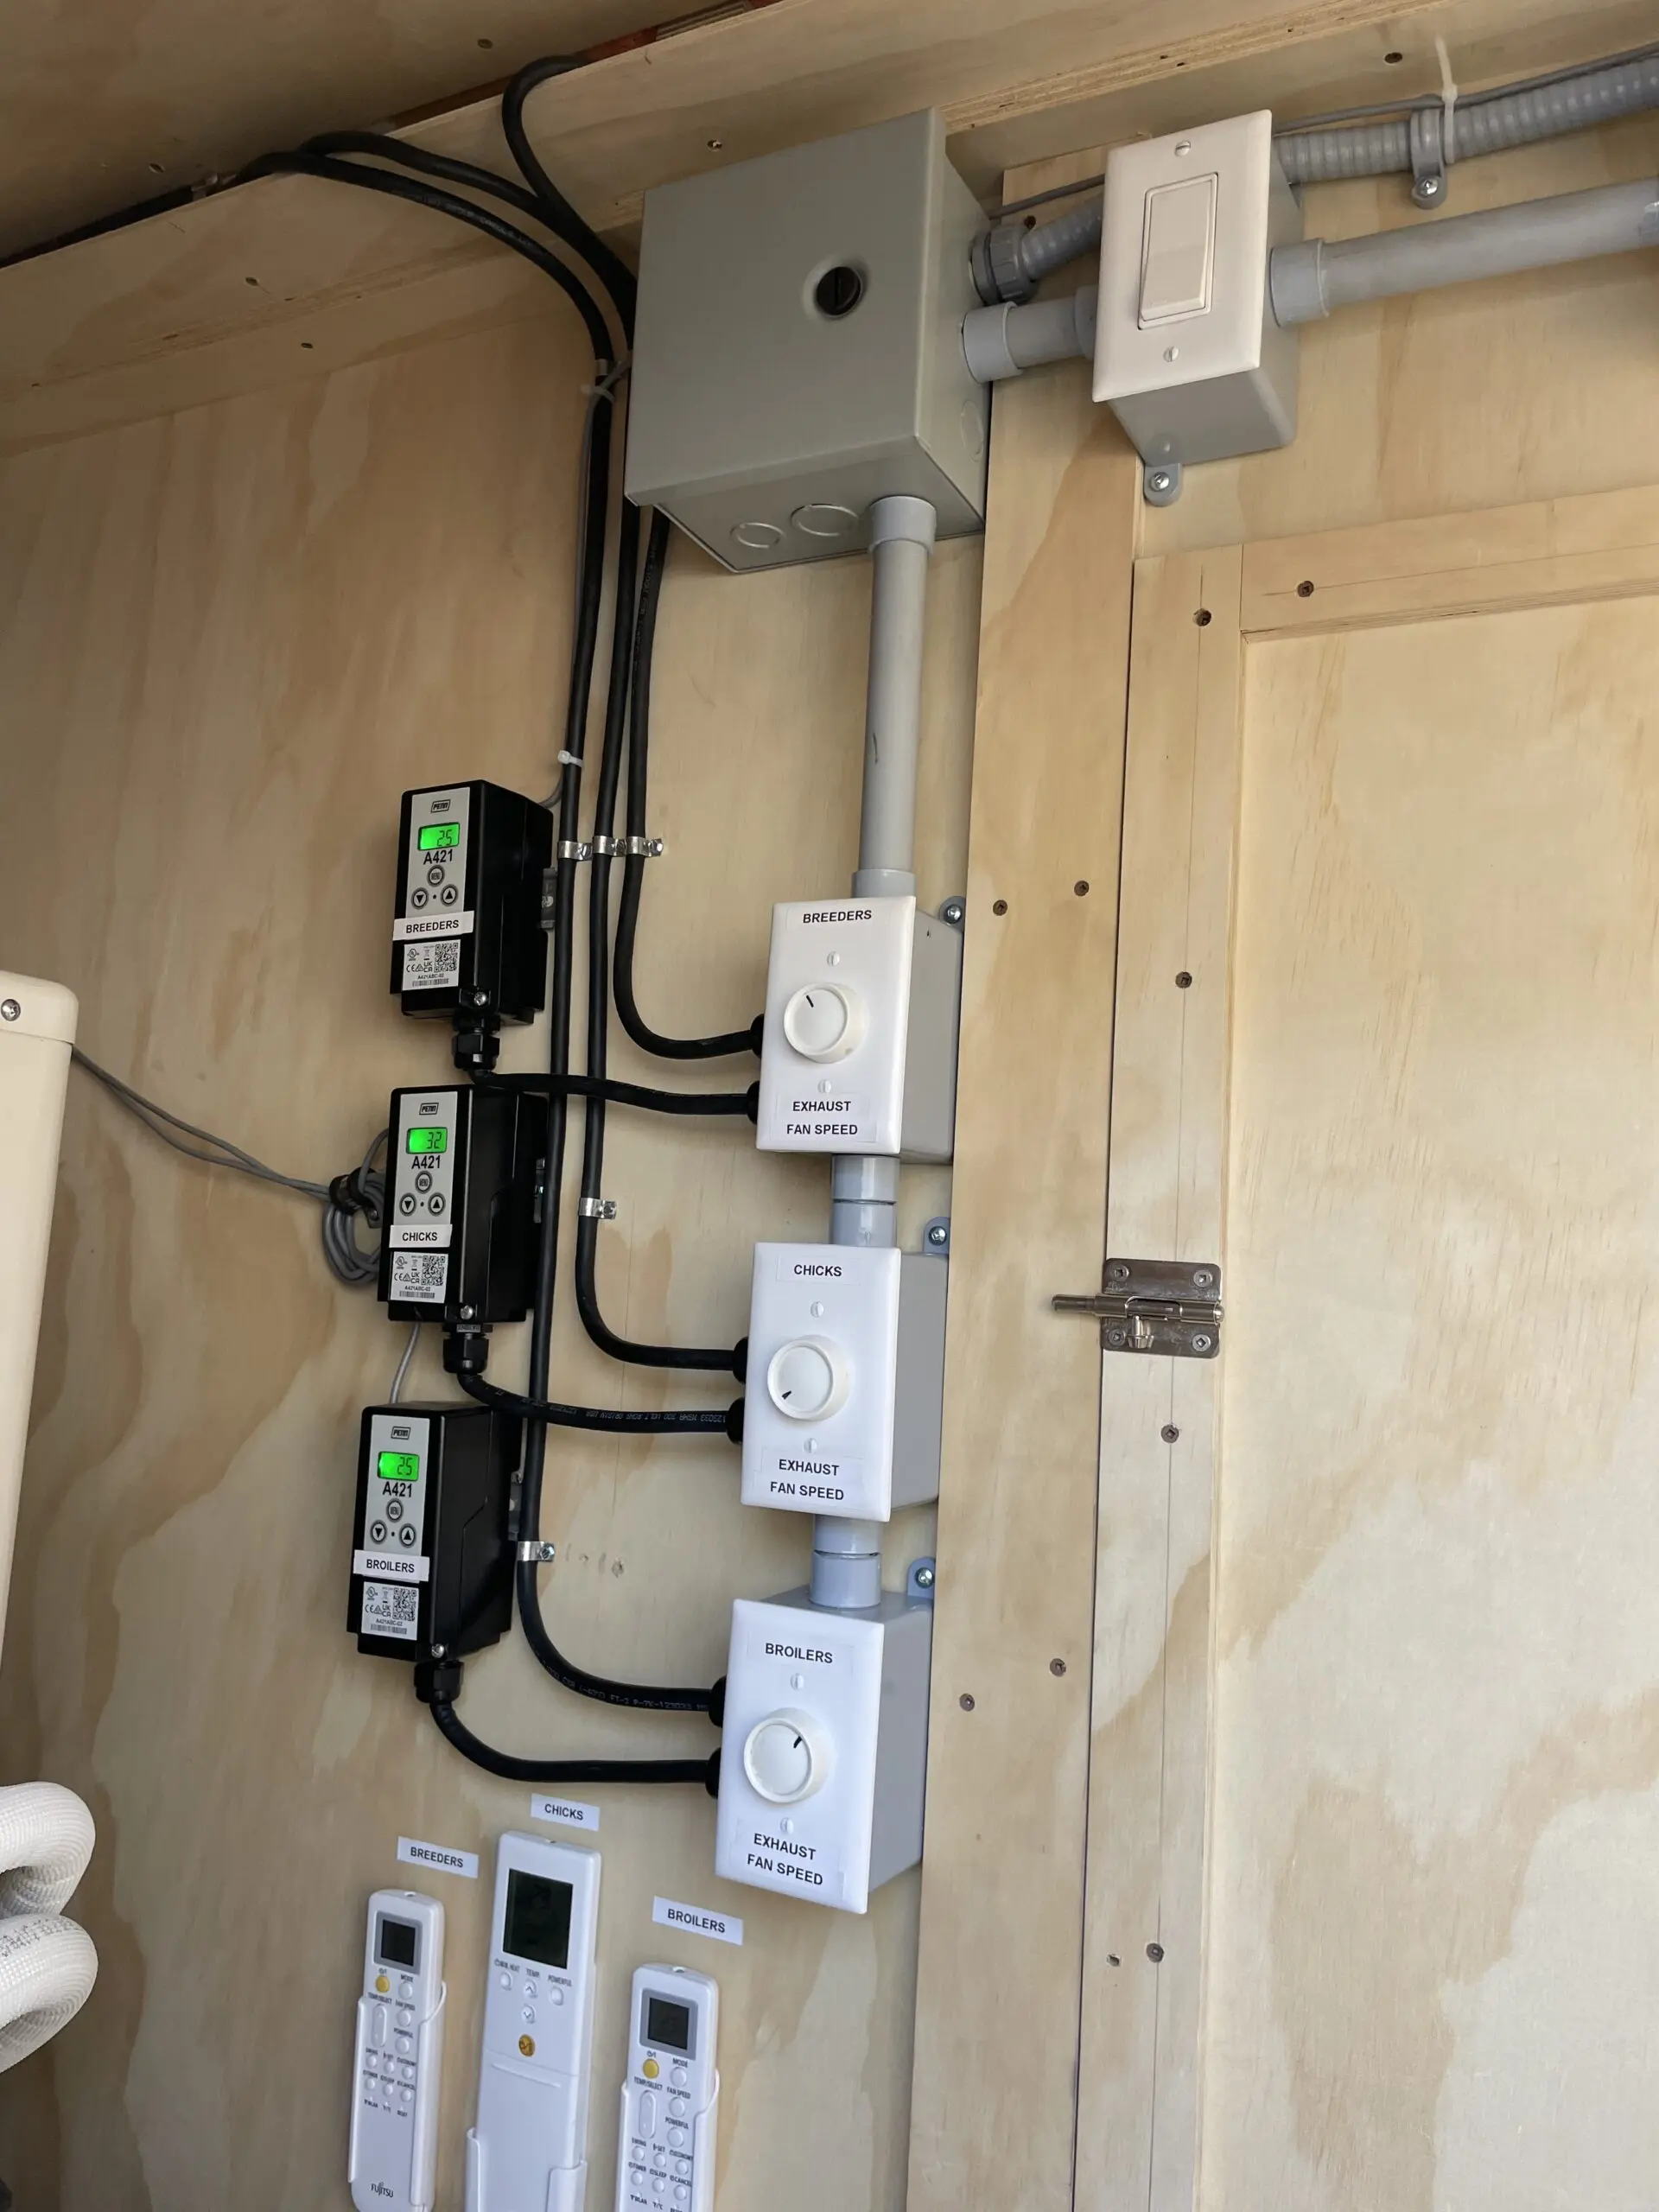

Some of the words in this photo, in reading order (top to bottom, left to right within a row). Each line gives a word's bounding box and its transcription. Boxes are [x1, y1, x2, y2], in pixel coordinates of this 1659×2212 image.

[436, 829, 452, 847] 25
[423, 849, 454, 865] A421
[803, 910, 872, 924] BREEDERS
[405, 920, 459, 934] BREEDERS
[792, 1101, 851, 1112] EXHAUST
[786, 1124, 810, 1135] FAN
[815, 1124, 858, 1135] SPEED
[427, 1131, 442, 1149] 32
[411, 1155, 441, 1170] A421
[402, 1231, 437, 1242] CHICKS
[793, 1264, 842, 1277] CHICKS
[397, 1456, 412, 1476] 25
[779, 1459, 839, 1476] EXHAUST
[383, 1481, 412, 1497] A421
[770, 1481, 796, 1495] FAN
[799, 1484, 844, 1501] SPEED
[365, 1559, 415, 1573] BROILERS
[765, 1643, 833, 1663] BROILERS
[544, 1803, 583, 1821] CHICKS
[753, 1833, 817, 1860] EXHAUST
[410, 1846, 464, 1868] BREEDERS
[747, 1853, 773, 1872] FAN
[777, 1862, 823, 1885] SPEED
[667, 1908, 726, 1933] BROILERS
[672, 2057, 689, 2068] MODE
[666, 2086, 677, 2095] FAN
[677, 2089, 691, 2100] SPEED
[664, 2116, 689, 2129] POWERFUL
[371, 2183, 394, 2198] FUJITSU
